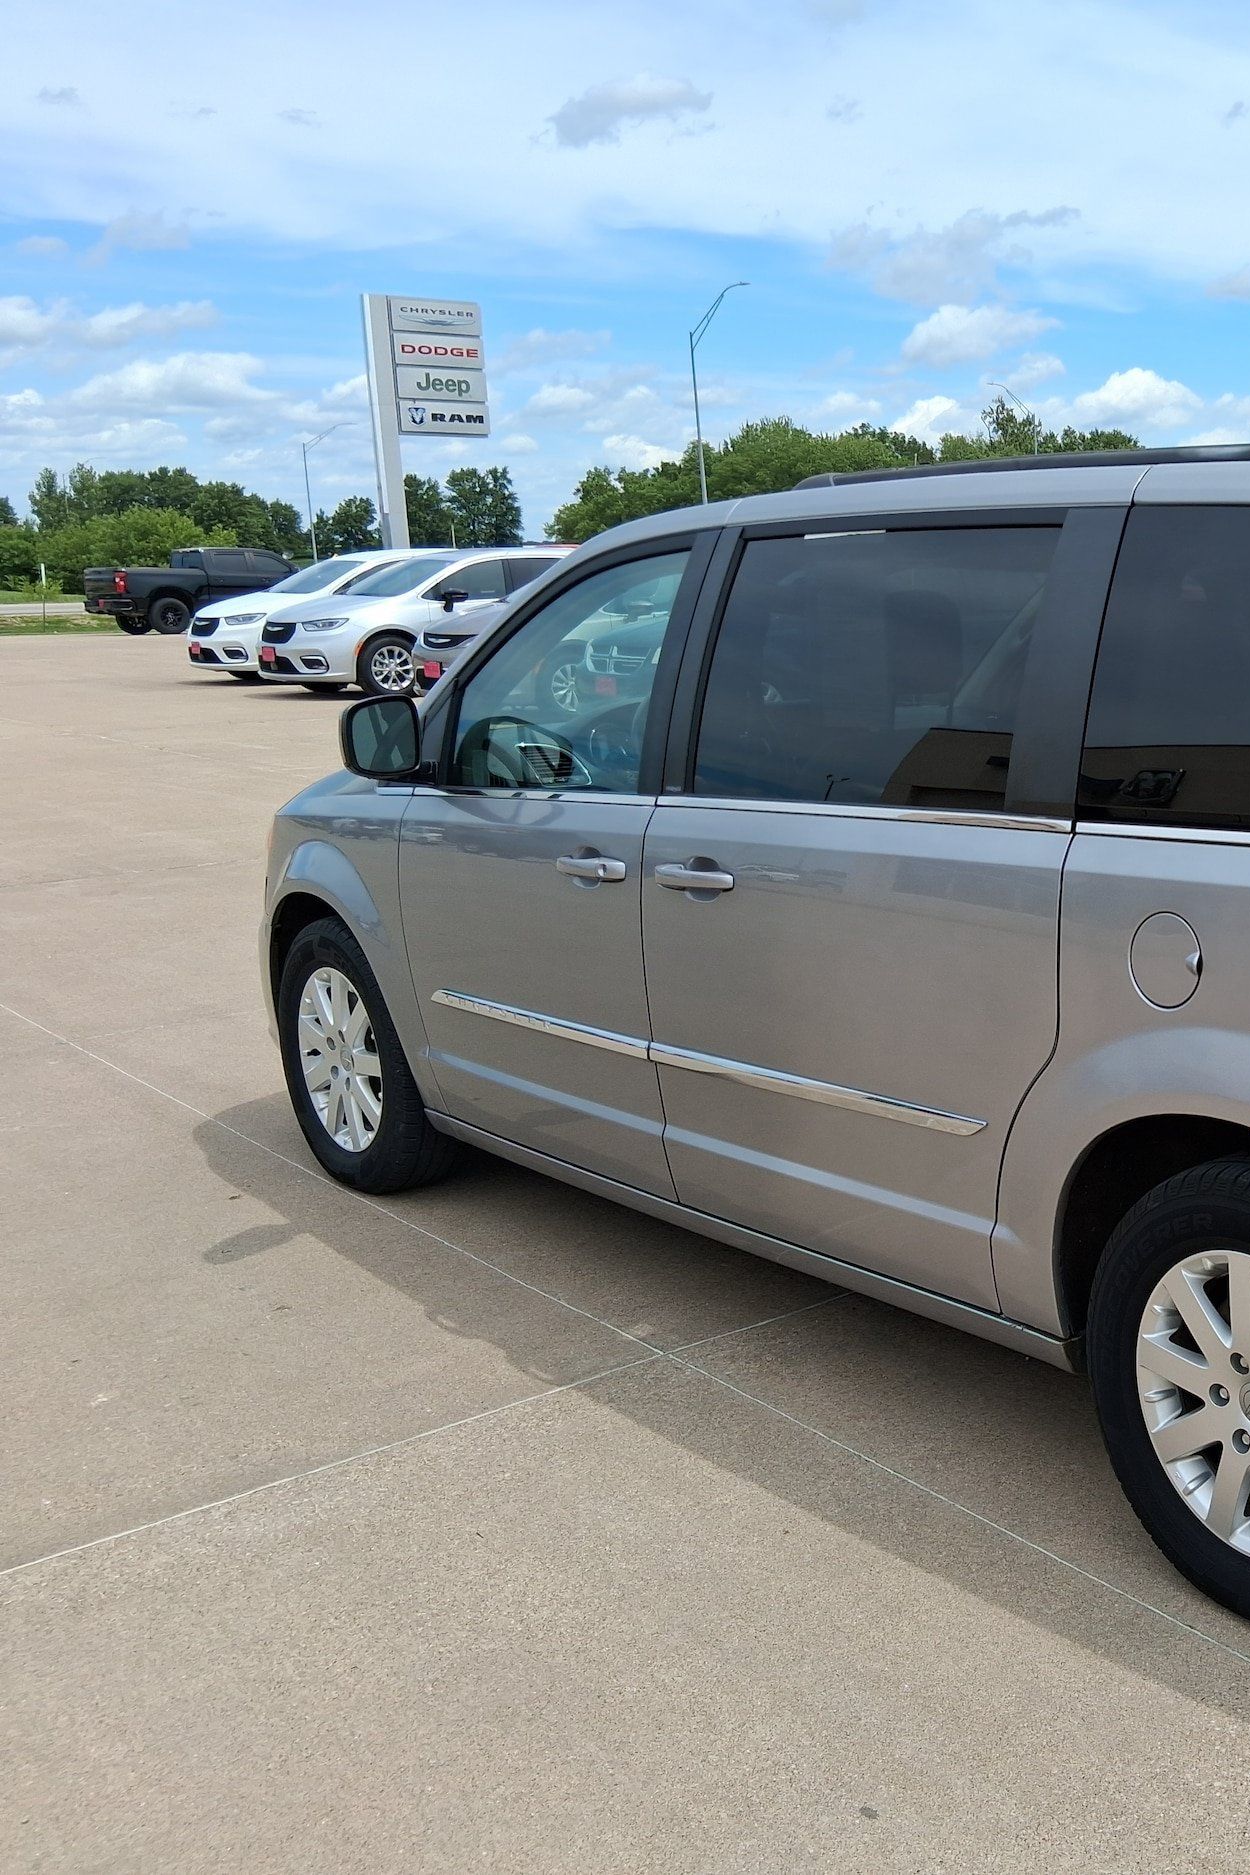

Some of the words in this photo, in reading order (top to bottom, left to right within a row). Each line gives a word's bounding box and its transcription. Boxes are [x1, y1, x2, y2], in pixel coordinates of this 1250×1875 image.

[400, 306, 474, 318] CHRYSLER
[401, 344, 479, 358] DODGE
[416, 372, 471, 397] Jeep
[431, 412, 485, 424] RAM
